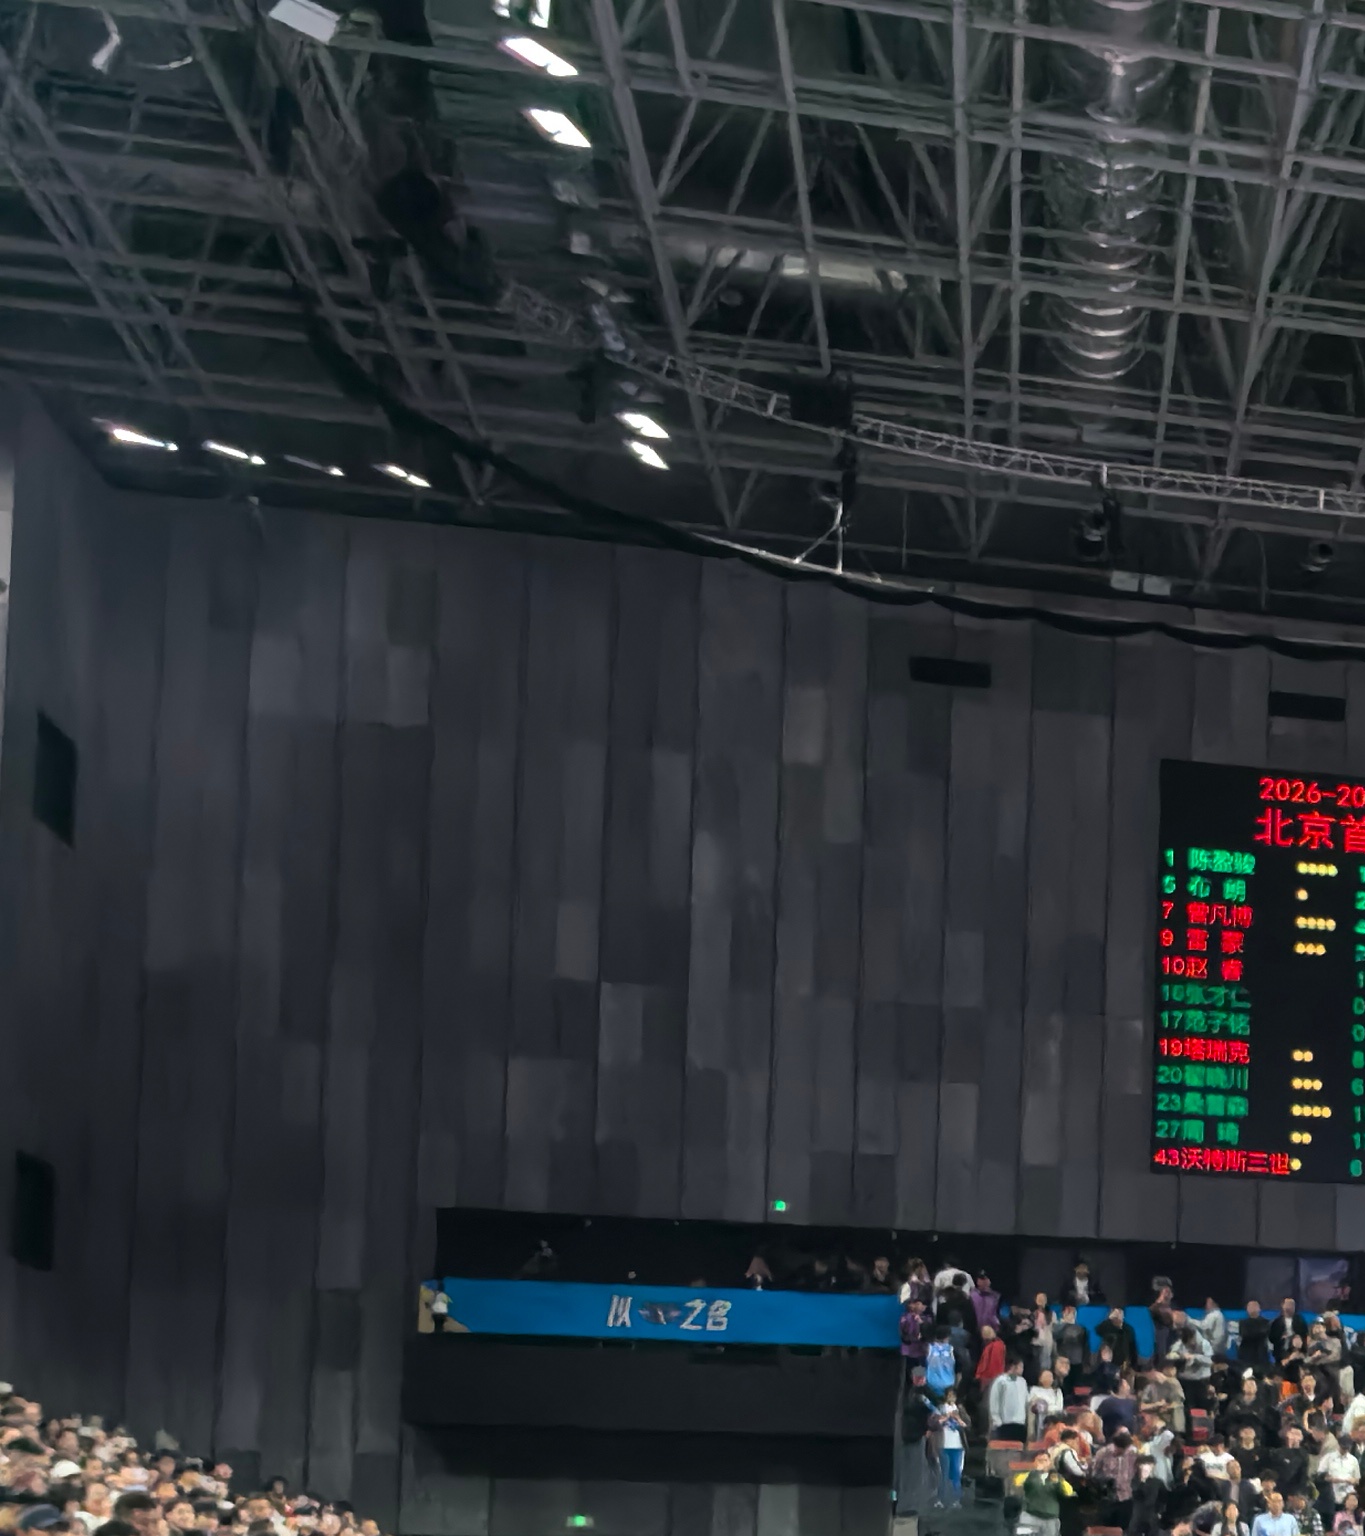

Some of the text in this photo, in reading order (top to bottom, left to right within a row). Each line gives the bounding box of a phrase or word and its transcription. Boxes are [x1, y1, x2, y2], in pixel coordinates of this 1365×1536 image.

[1164, 848, 1174, 867] 1
[1162, 901, 1174, 919] 7
[1161, 929, 1174, 947] 9
[1162, 955, 1185, 975] 10
[1161, 1010, 1183, 1029] 17
[1160, 1038, 1182, 1056] 19
[1156, 1065, 1183, 1084] 20
[1157, 1093, 1181, 1112] 23
[1155, 1119, 1180, 1138] 27
[1153, 1148, 1179, 1166] 43
